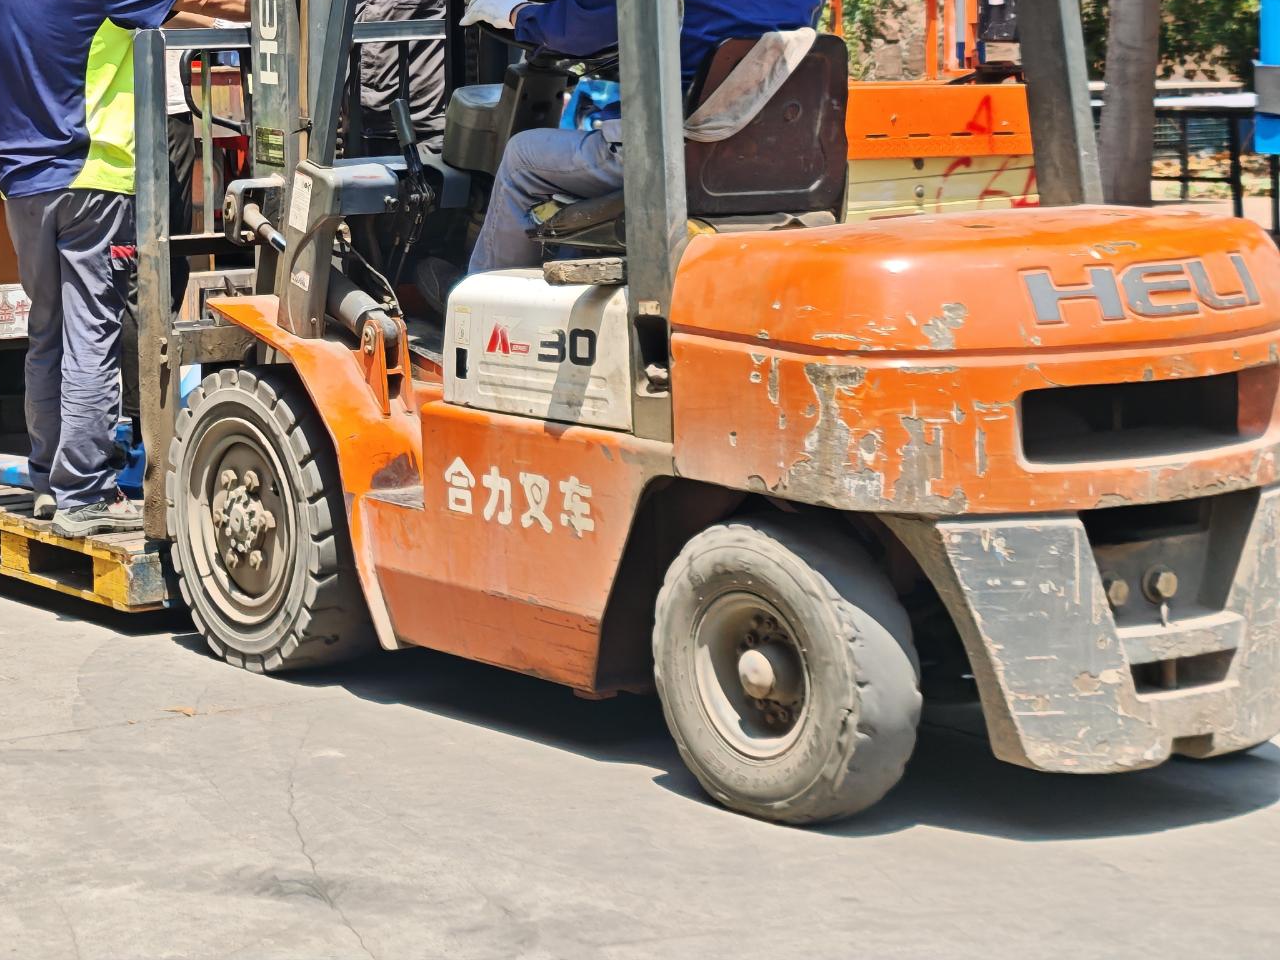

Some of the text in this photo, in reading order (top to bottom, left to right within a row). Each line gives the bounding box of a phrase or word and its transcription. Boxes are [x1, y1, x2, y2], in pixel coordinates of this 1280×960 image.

[1022, 252, 1262, 325] HELI
[536, 326, 597, 368] 30
[444, 456, 596, 538] 合力叉车
